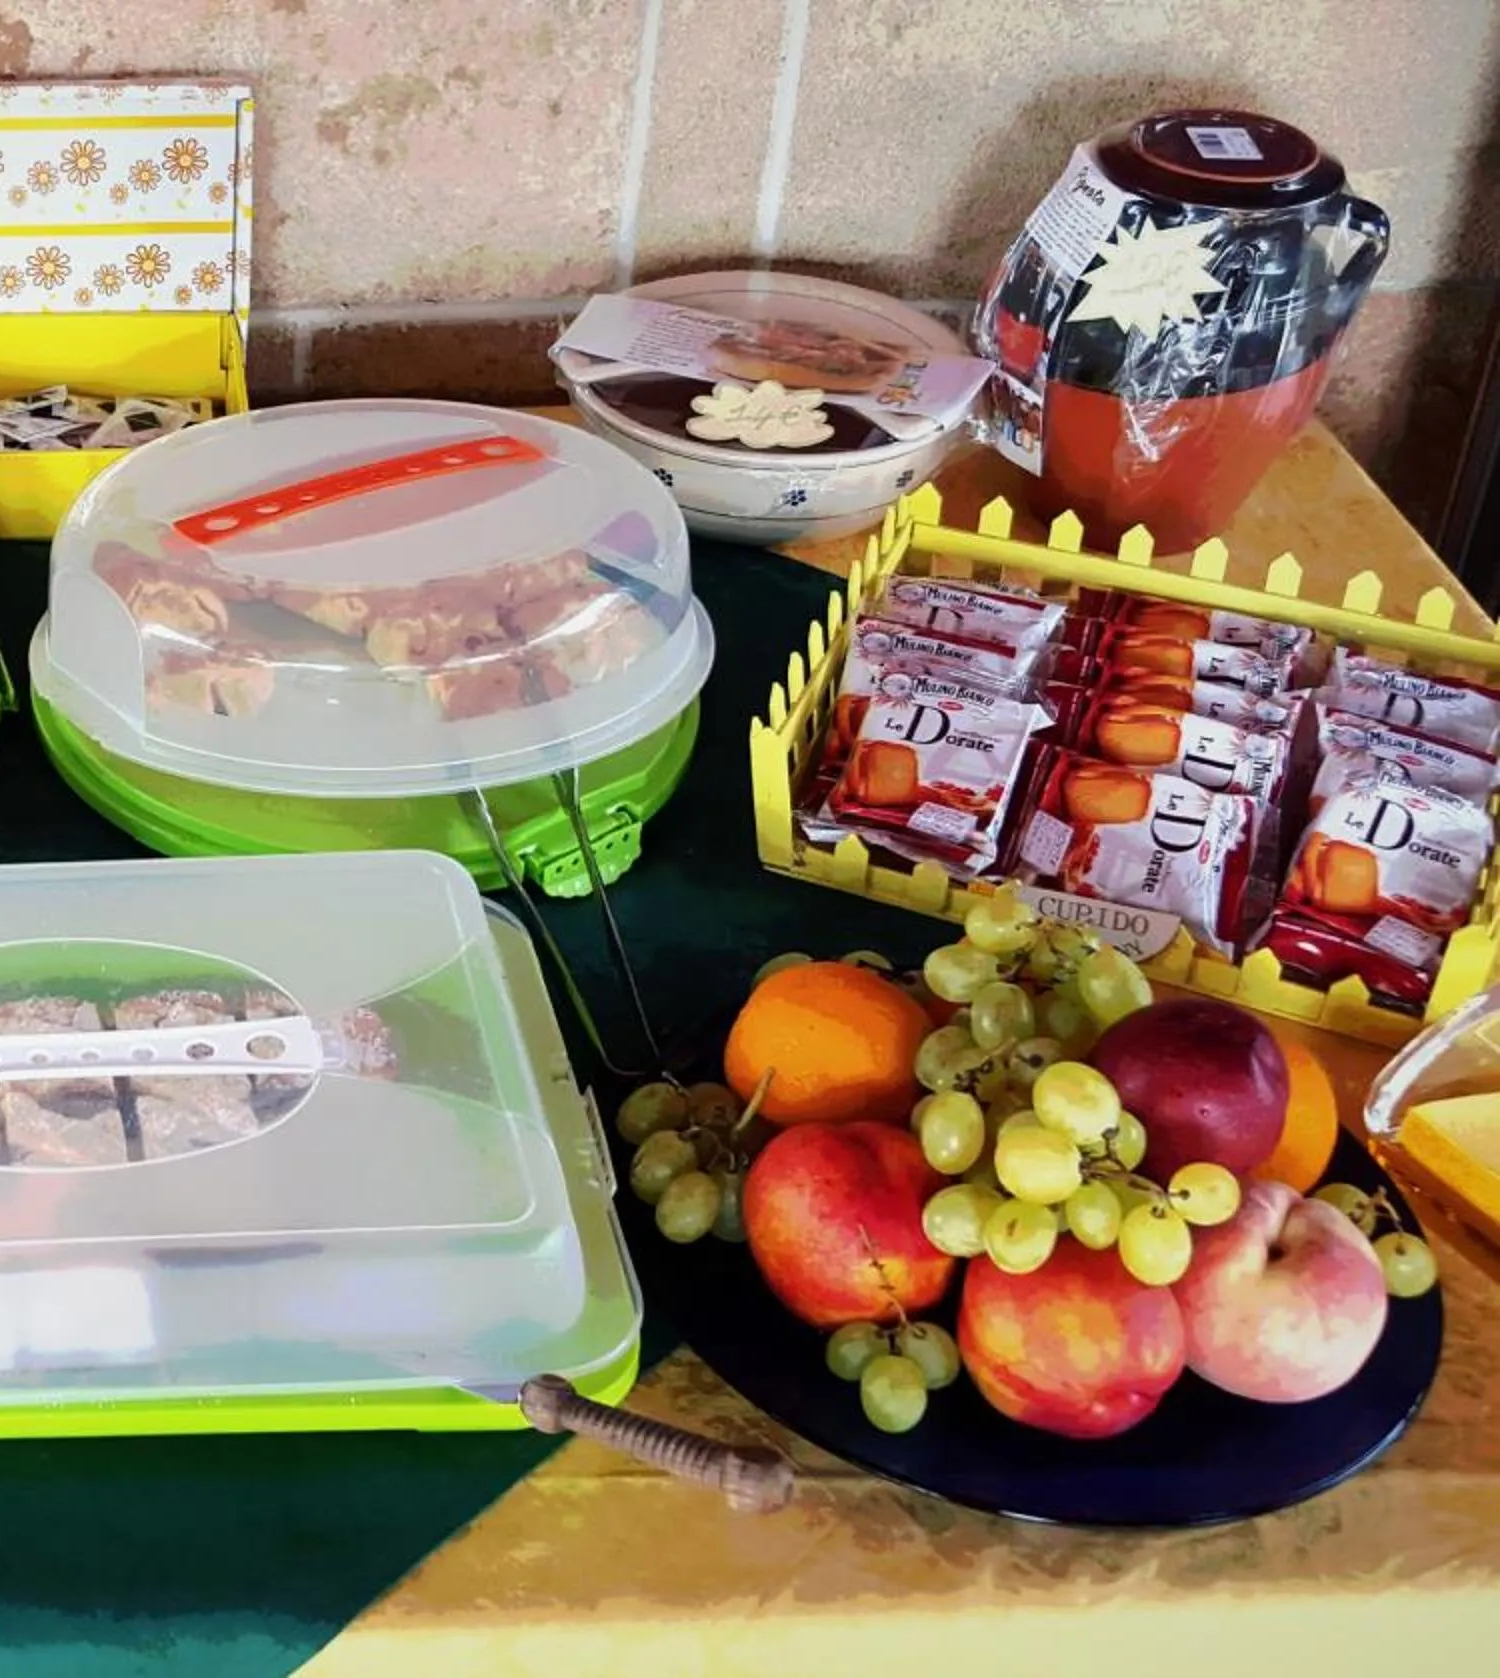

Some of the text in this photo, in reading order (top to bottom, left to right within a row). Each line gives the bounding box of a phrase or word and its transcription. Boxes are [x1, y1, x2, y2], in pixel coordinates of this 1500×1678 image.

[884, 717, 905, 732] Le
[1167, 794, 1185, 811] Le
[1343, 811, 1365, 828] Le
[1037, 895, 1150, 937] CUPIDO
